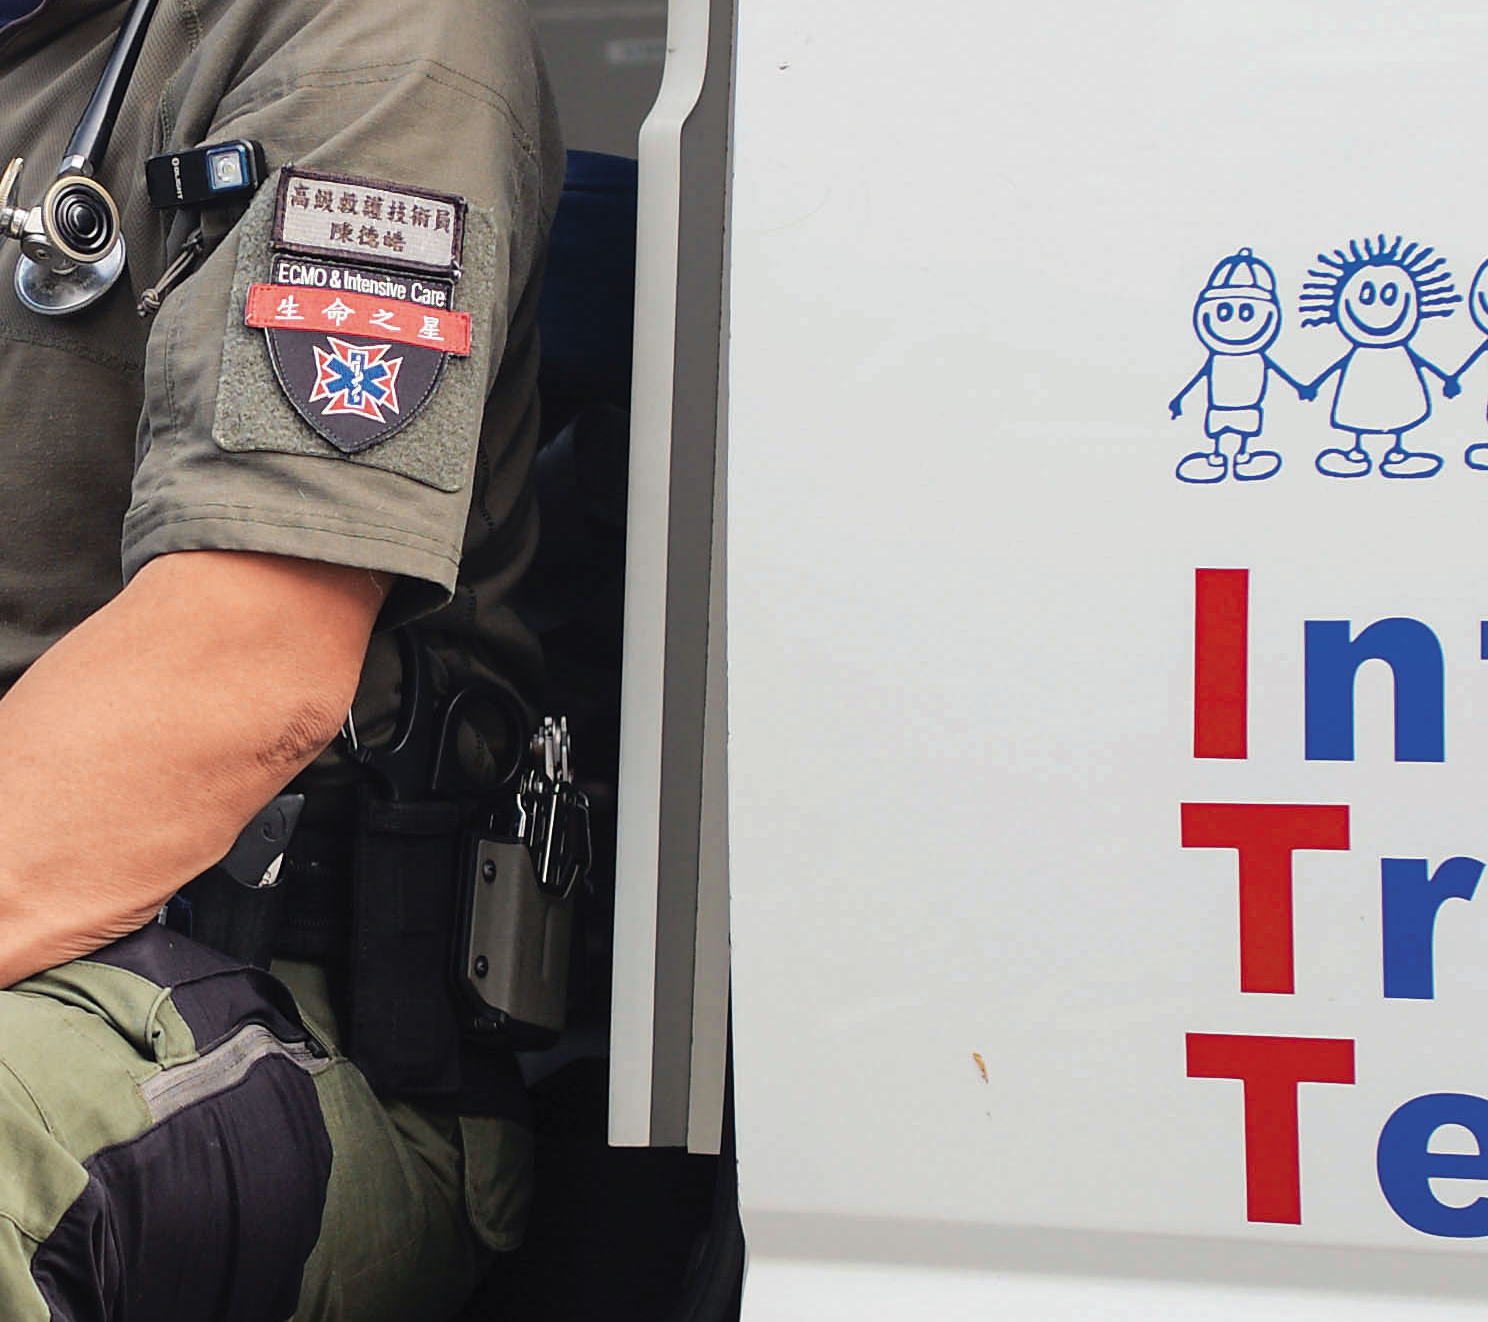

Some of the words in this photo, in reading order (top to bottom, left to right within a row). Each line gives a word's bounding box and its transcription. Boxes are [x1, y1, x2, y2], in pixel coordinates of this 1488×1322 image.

[278, 263, 327, 287] ECMO
[329, 274, 342, 289] &
[343, 270, 407, 300] Intensive
[410, 282, 447, 308] Care
[275, 294, 445, 341] 生命之星
